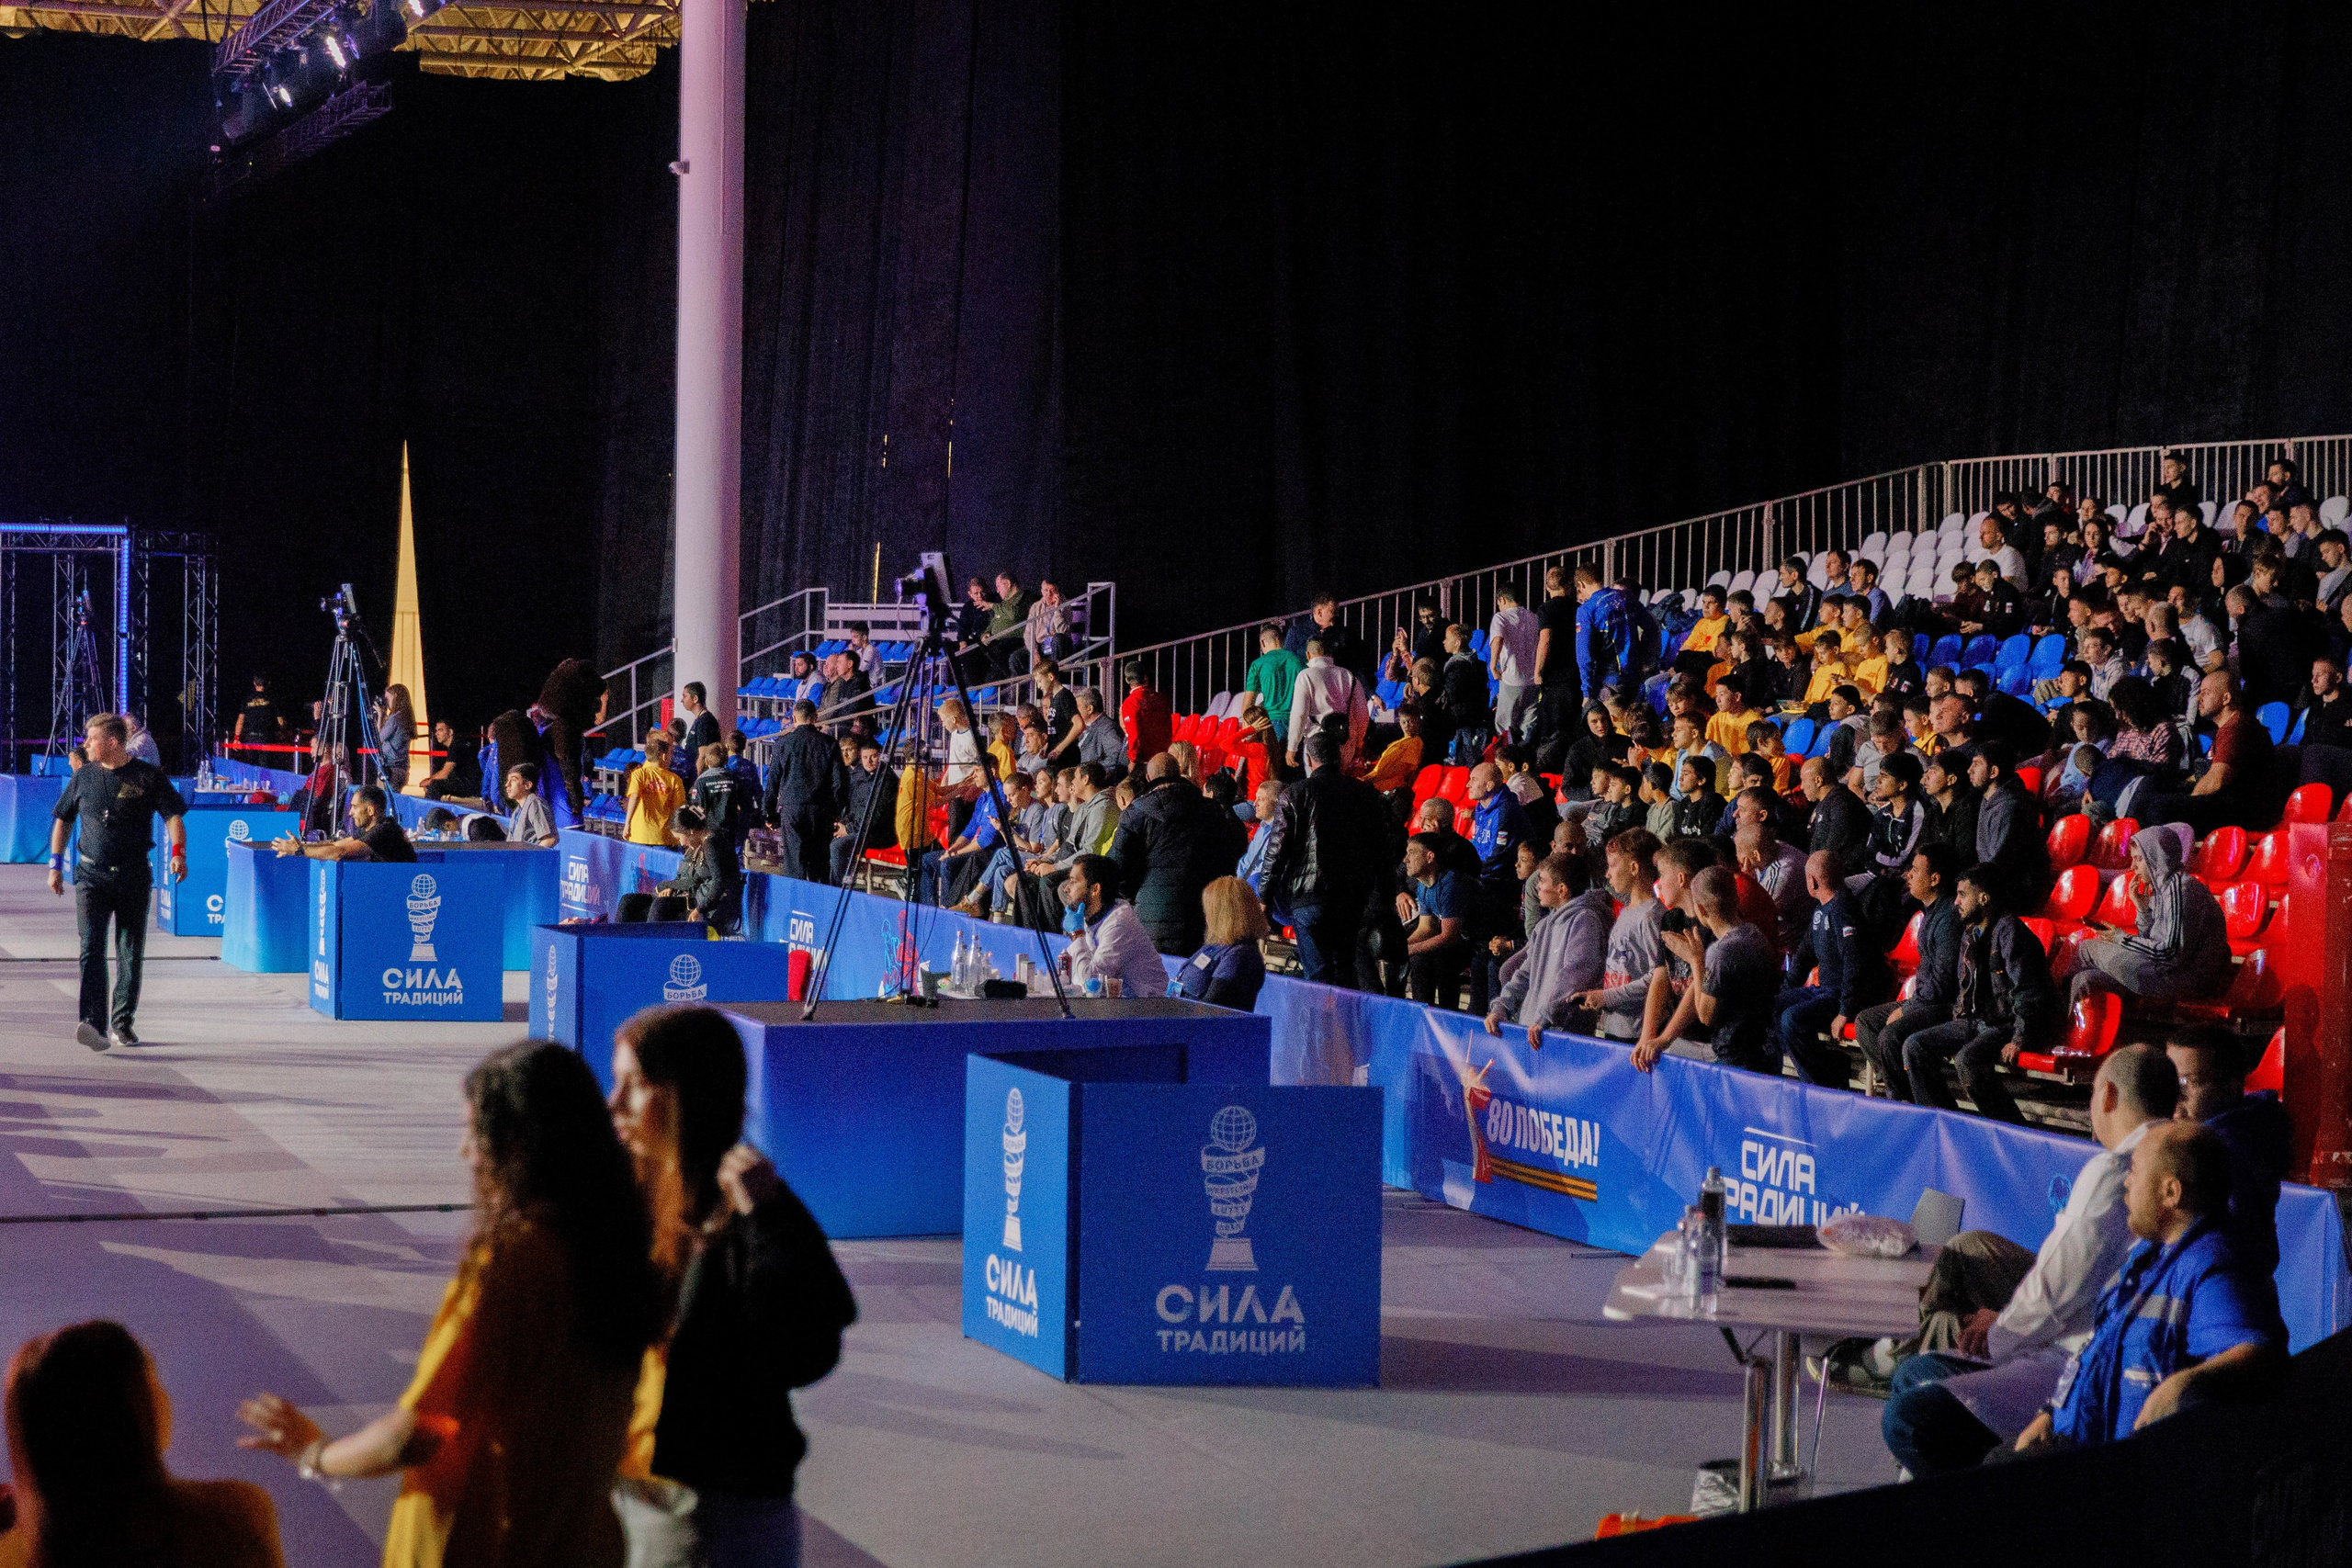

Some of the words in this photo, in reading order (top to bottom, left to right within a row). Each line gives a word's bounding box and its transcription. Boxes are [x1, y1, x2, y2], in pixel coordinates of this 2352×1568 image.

[569, 862, 589, 883] СИЛА
[409, 900, 438, 908] БОРЬБА
[790, 918, 814, 944] СИЛА
[382, 967, 463, 989] СИЛА
[382, 989, 463, 1006] ТРАДИЦИЙ
[667, 988, 705, 999] БОРЬБА
[1487, 1098, 1513, 1145] 80
[1514, 1105, 1600, 1169] ПОБЕДА!
[1206, 1156, 1259, 1169] БОРЬБА
[1742, 1140, 1815, 1195] СИЛА
[986, 1254, 1038, 1309] СИЛА
[986, 1296, 1038, 1338] ТРАДИЦИЙ
[1156, 1285, 1306, 1323] СИЛА
[1156, 1325, 1306, 1356] ТРАДИЦИЙ
